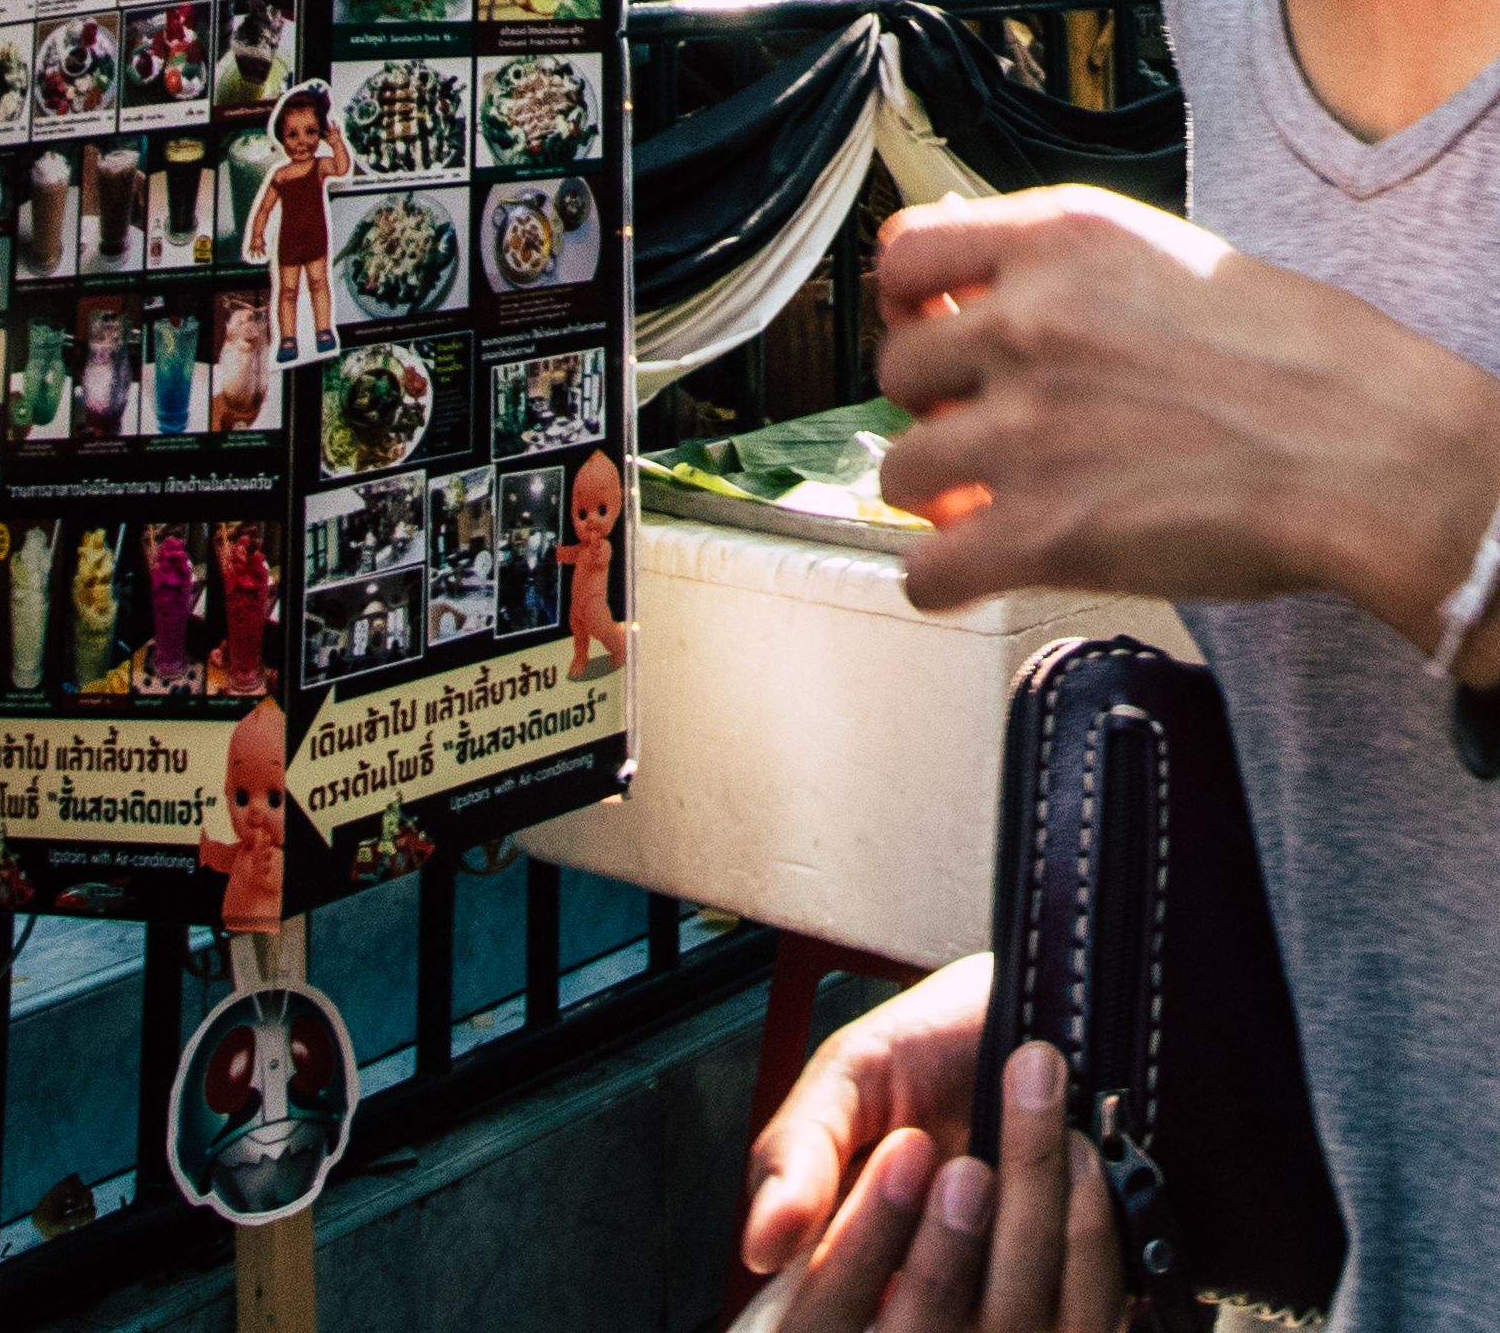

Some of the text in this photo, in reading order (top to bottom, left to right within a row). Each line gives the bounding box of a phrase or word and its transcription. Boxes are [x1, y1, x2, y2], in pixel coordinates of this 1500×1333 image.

[55, 724, 189, 773] แล้วเลี้ยวซ้าย
[311, 661, 558, 761] เดินเข้าไป แล้วเลี้ยวซ้าย
[307, 729, 435, 812] ตรงต้นโพธิ์
